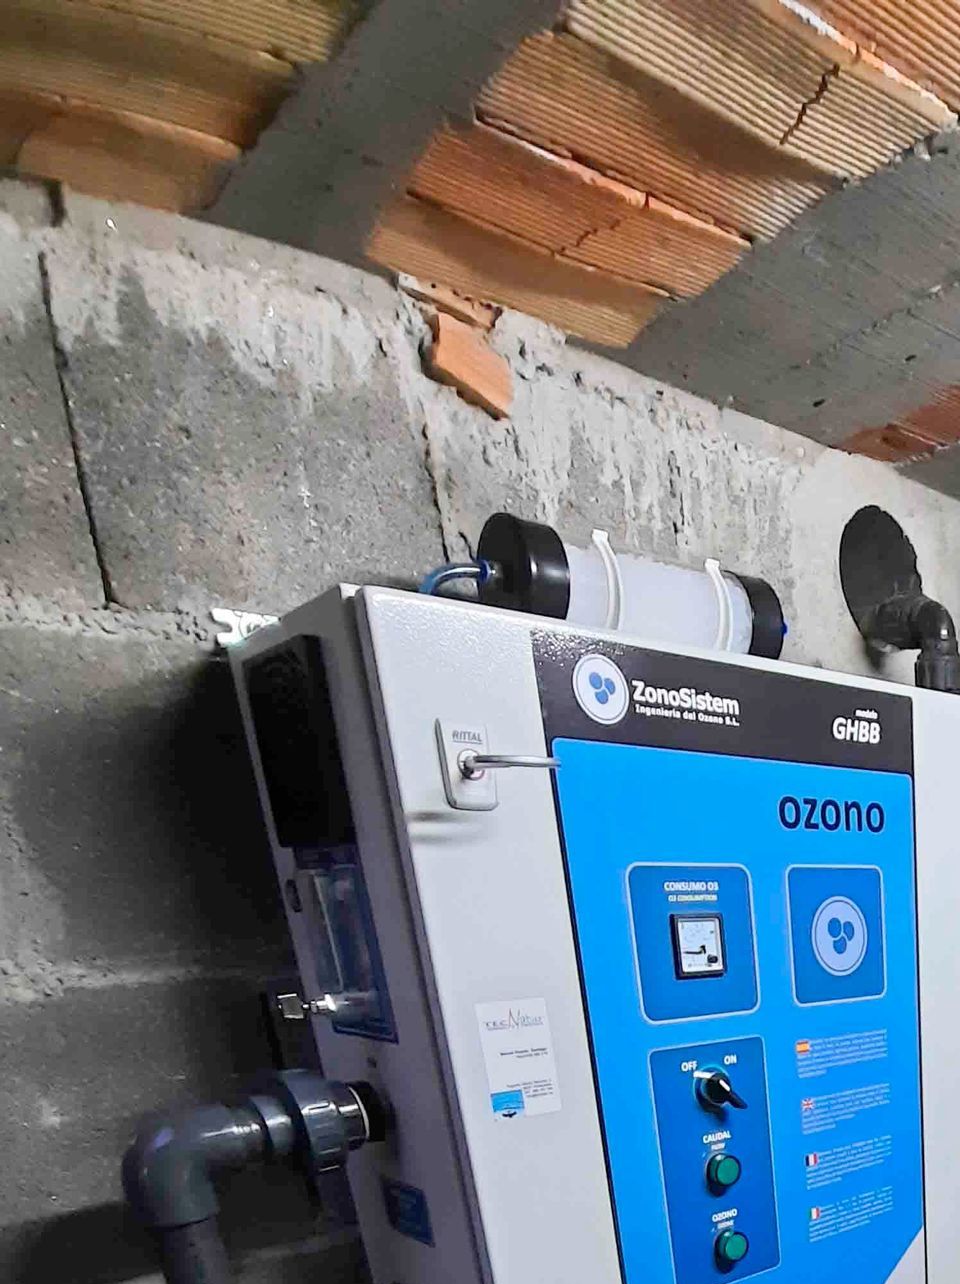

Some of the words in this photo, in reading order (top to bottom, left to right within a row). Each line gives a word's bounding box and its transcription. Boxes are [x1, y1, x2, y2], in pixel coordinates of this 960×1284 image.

[631, 679, 740, 715] ZonoSistem
[452, 729, 482, 742] RITTAL
[664, 881, 706, 891] CONSUMO
[681, 1060, 698, 1072] OFF
[724, 1055, 738, 1065] ON
[702, 1130, 732, 1144] CAUDAL
[712, 1208, 738, 1223] OZONO
